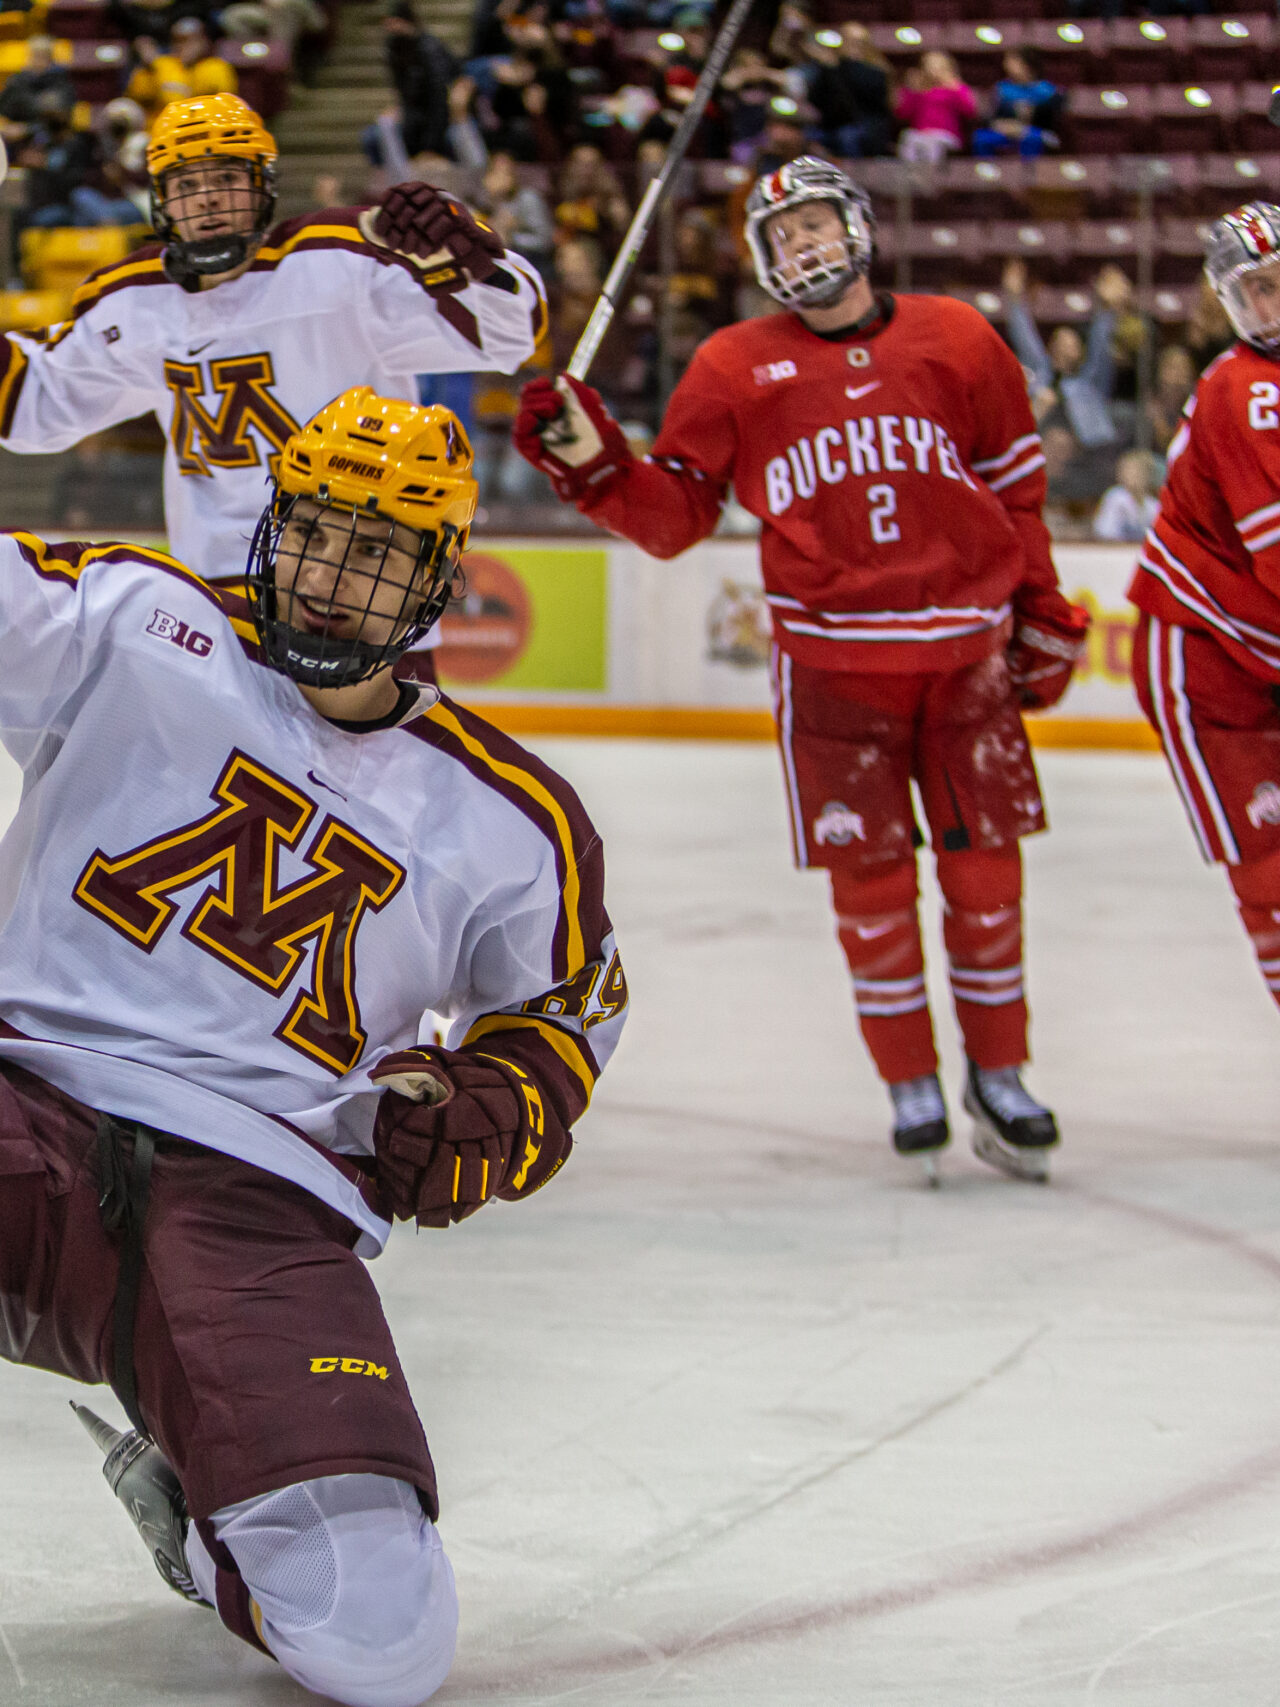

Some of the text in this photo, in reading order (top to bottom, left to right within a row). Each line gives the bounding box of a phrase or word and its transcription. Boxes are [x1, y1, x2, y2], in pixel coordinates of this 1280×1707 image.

[1248, 381, 1280, 430] 2
[327, 454, 386, 482] GOPHERS
[765, 414, 979, 516] BUCKEYE
[866, 483, 901, 544] 2
[287, 649, 339, 671] CCM
[72, 746, 408, 1079] M
[309, 1357, 392, 1380] CCM
